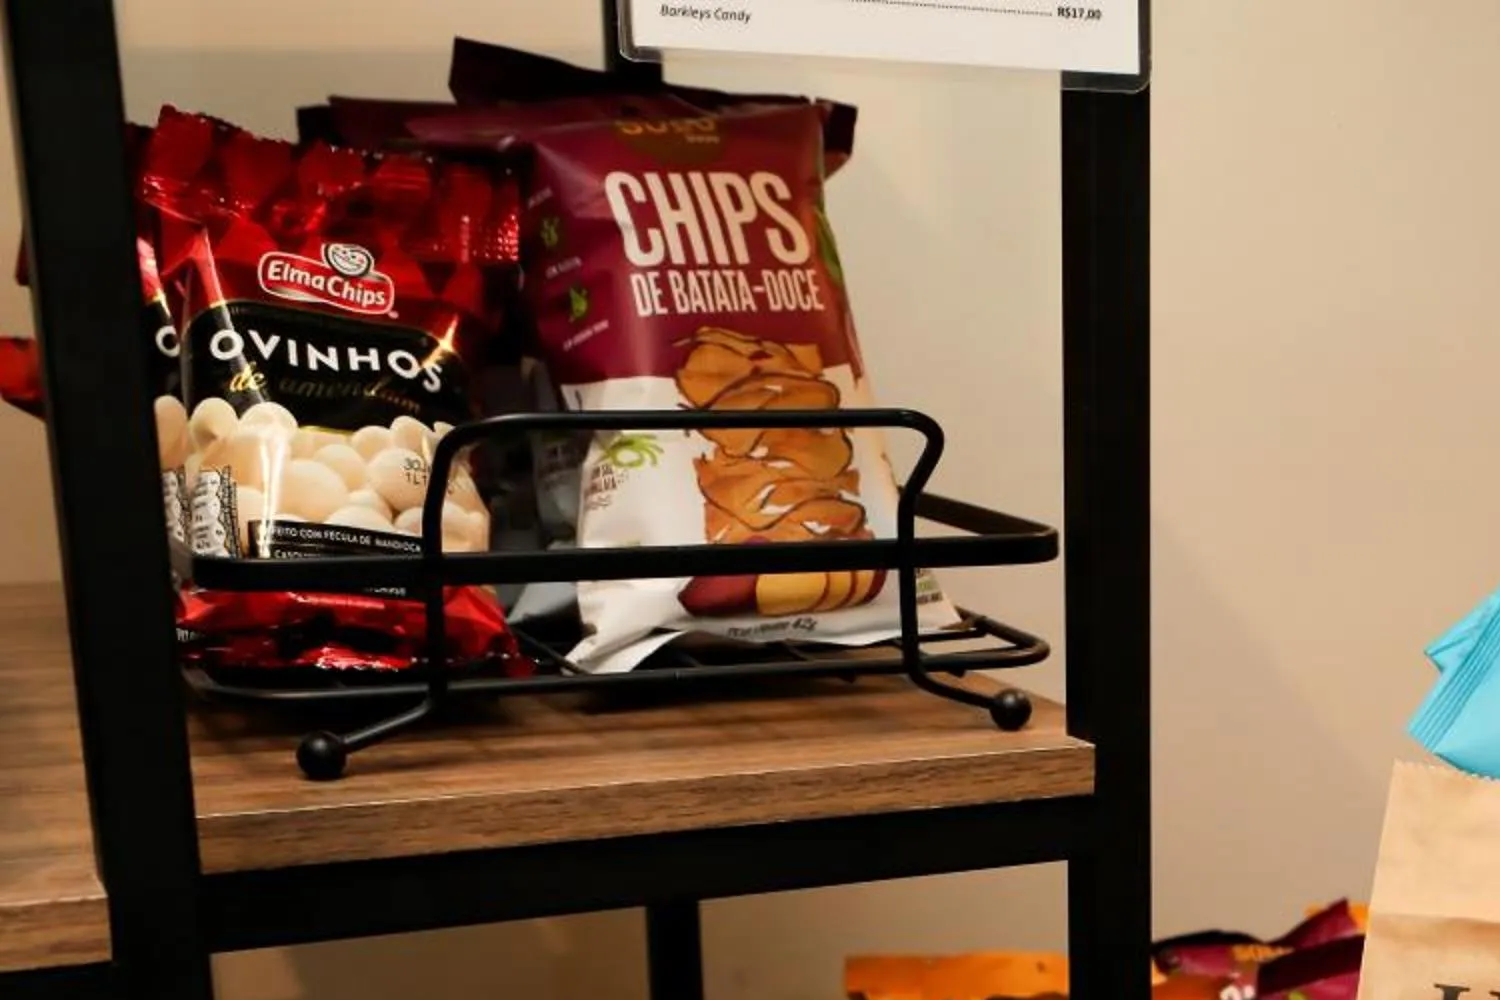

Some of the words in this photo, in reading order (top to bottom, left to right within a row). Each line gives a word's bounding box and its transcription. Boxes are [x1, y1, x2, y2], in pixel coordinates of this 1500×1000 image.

[713, 7, 752, 24] Candy
[1057, 6, 1102, 21] R$17,00
[605, 171, 810, 267] CHIPS
[630, 271, 668, 317] DE
[667, 269, 825, 314] BATATA-DOCE
[210, 329, 443, 393] OVINHOS
